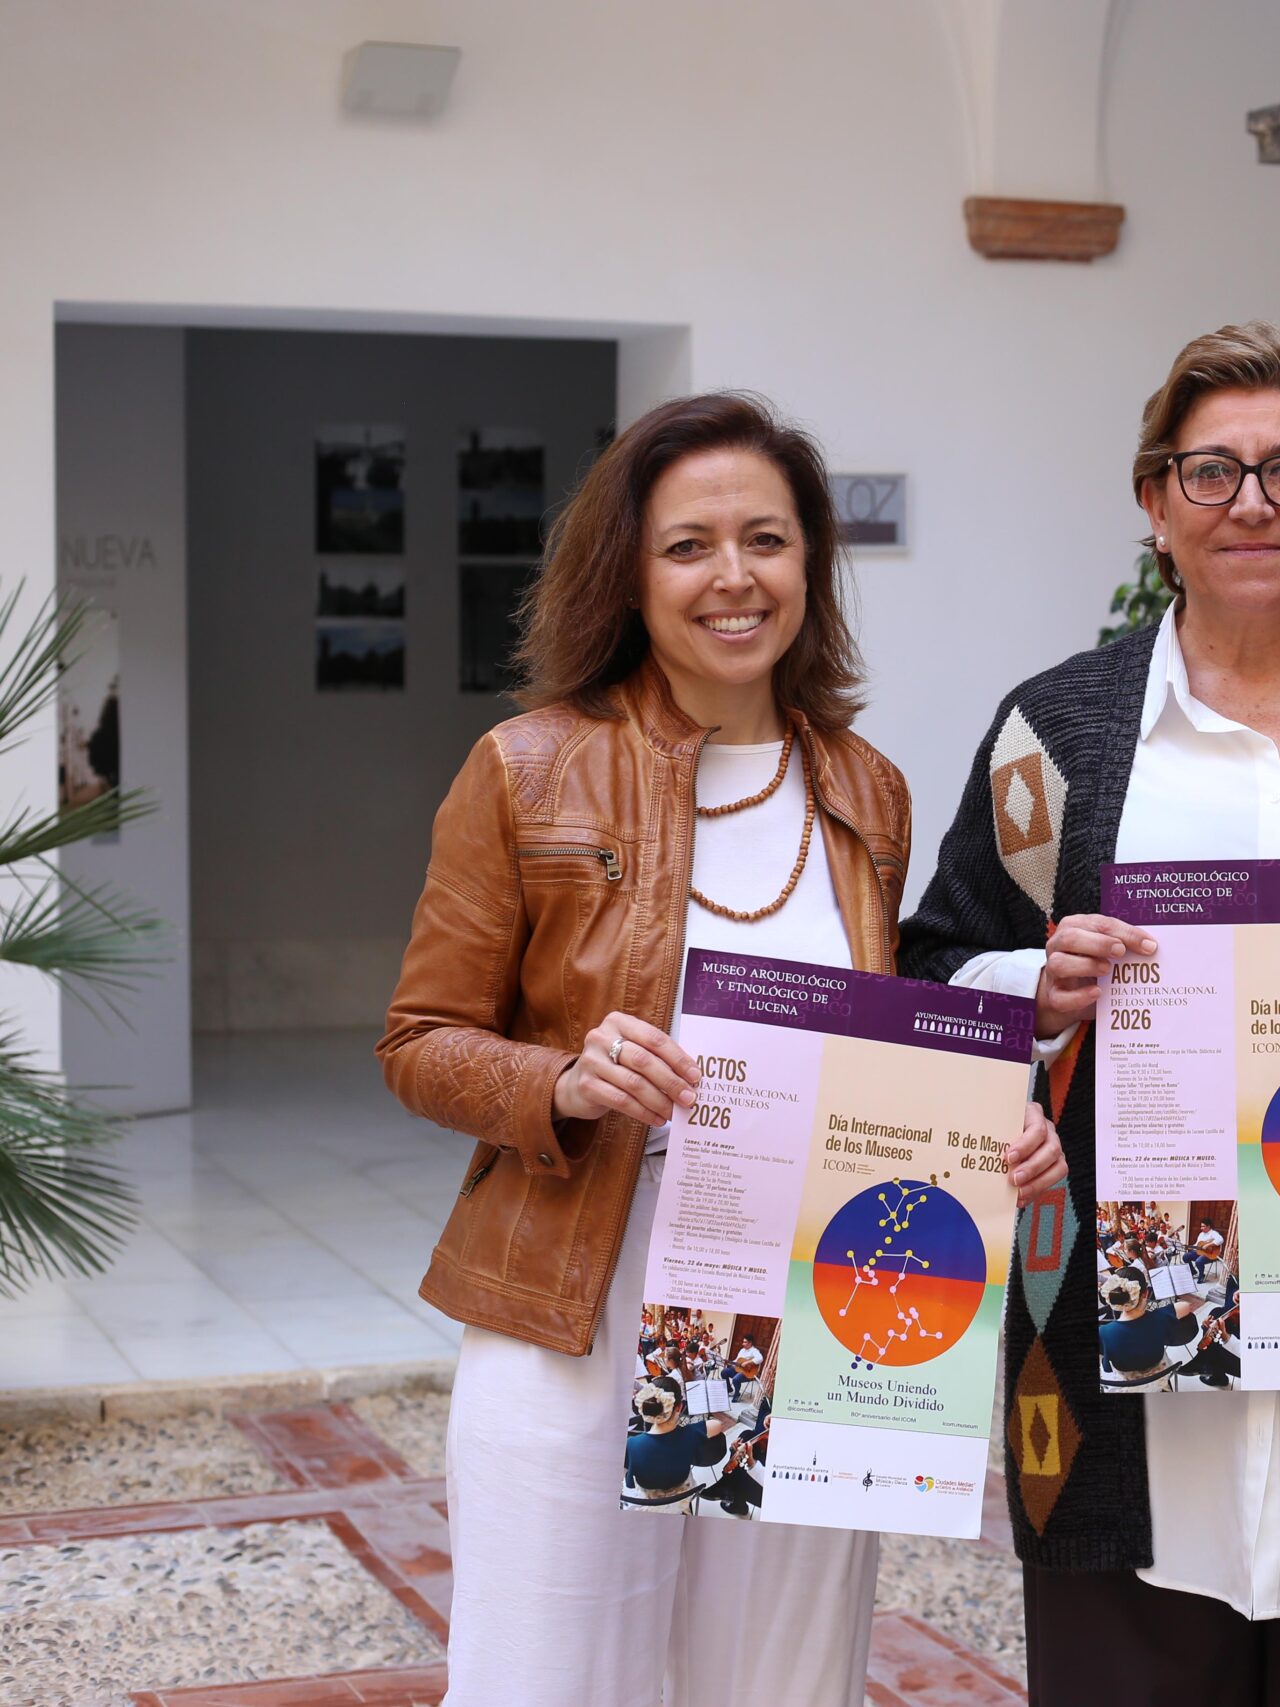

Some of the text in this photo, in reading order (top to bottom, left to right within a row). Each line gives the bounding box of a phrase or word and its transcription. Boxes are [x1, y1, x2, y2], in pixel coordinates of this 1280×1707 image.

[61, 533, 157, 570] NUEVA
[1114, 870, 1249, 884] MUSEO ARQUEOLÓGICO
[1126, 885, 1232, 898] Y ETNOLÓGICO DE
[1155, 903, 1203, 913] LUCENA
[702, 960, 846, 993] MUSEO ARQUEOLÓGICO
[1111, 962, 1160, 984] ACTOS
[716, 979, 828, 1004] Y ETNOLÓGICO DE
[1130, 986, 1217, 995] INTERNACIONAL
[748, 999, 798, 1016] LUCENA
[1111, 997, 1187, 1006] DE LOS MUSEOS
[1250, 999, 1270, 1015] Día
[914, 1010, 967, 1025] AYUNTAMIENTO
[977, 1021, 1003, 1030] LUCENA
[1111, 1008, 1151, 1030] 2026
[1251, 1019, 1266, 1034] de
[695, 1055, 747, 1082] ACTOS
[706, 1093, 726, 1104] LOS
[728, 1096, 770, 1110] MUSEOS
[713, 1082, 800, 1102] INTERNACIONAL
[688, 1103, 731, 1129] 2026
[828, 1112, 932, 1143] Día Internacional
[825, 1134, 913, 1161] de los Museos
[945, 1130, 960, 1147] 18
[962, 1132, 978, 1149] de
[822, 1158, 856, 1173] ICOM
[960, 1152, 1009, 1174] de 2026
[837, 1374, 937, 1396] Museos Uniendo
[826, 1390, 944, 1412] un Mundo Dividido
